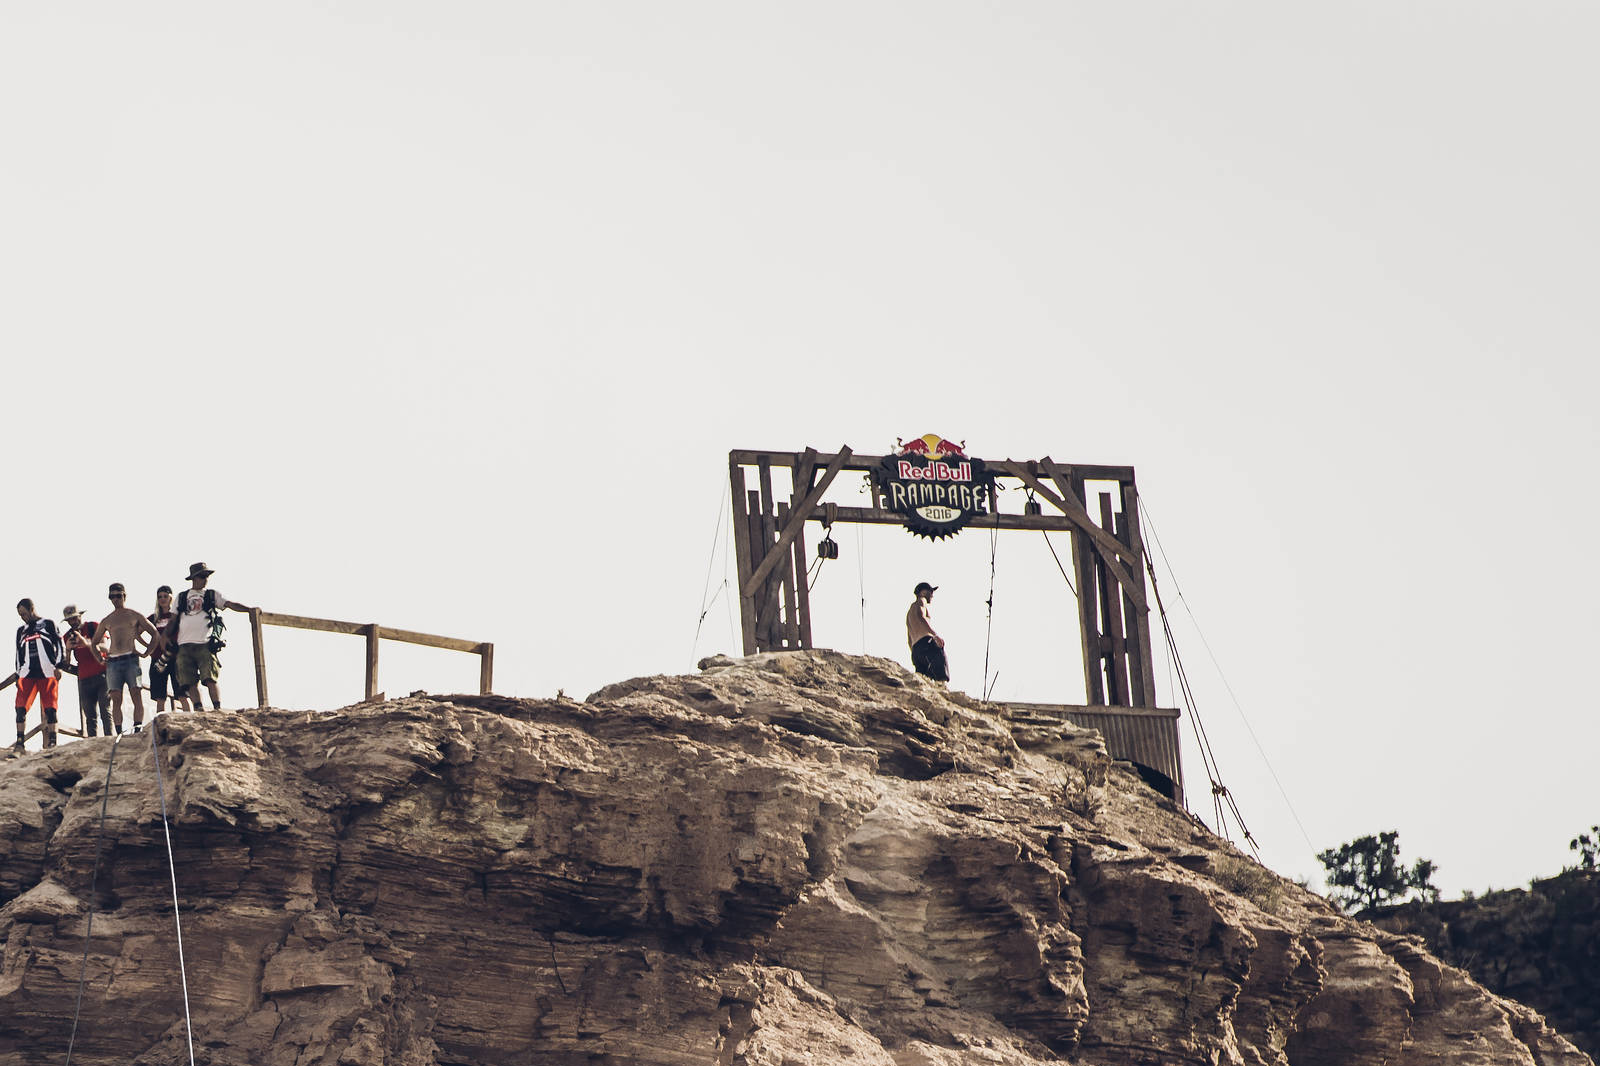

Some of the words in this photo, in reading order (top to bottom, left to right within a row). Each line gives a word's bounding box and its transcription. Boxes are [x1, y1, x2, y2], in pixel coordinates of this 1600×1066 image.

[898, 461, 935, 480] Red
[936, 462, 971, 482] Bull
[890, 482, 983, 512] RAMPAGE
[925, 508, 952, 519] 2016
